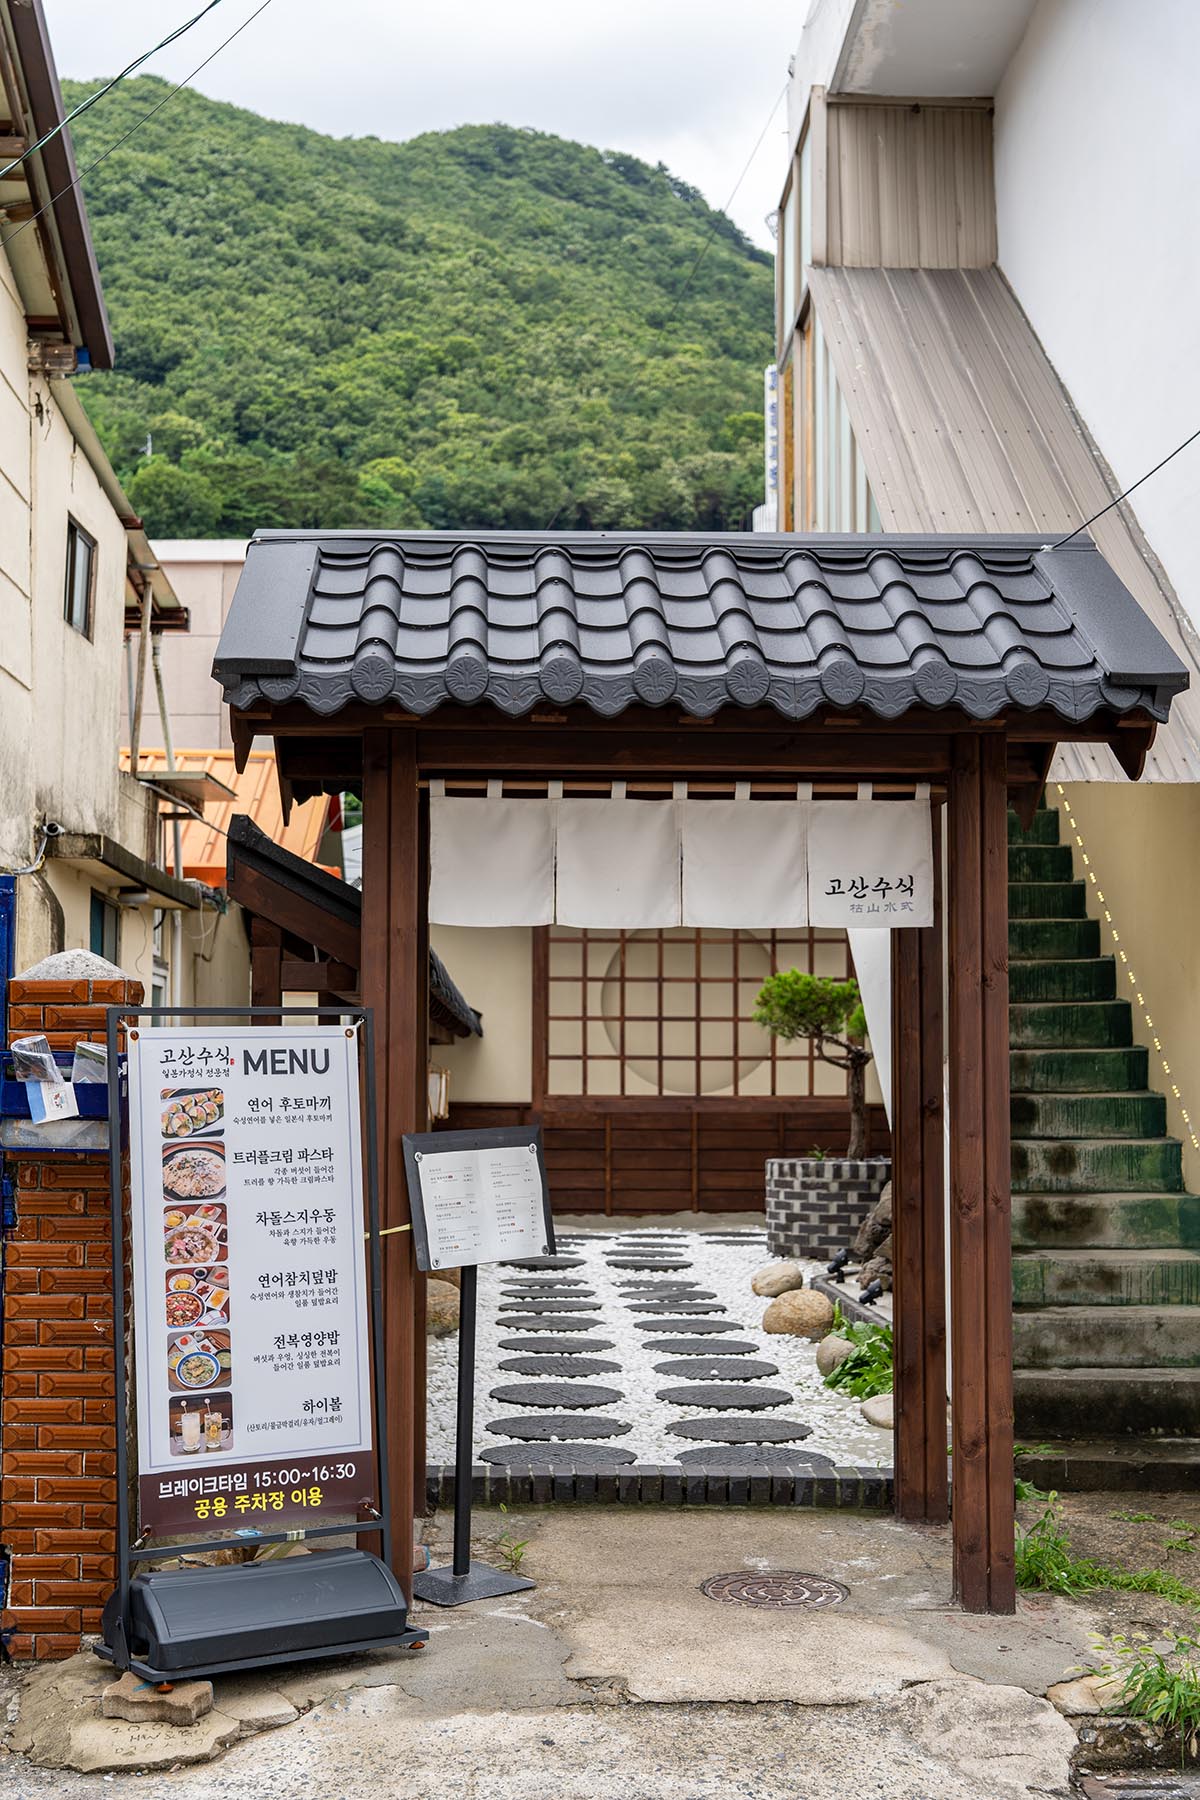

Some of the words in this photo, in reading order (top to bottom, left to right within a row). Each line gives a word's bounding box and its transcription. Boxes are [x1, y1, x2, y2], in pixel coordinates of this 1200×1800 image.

[825, 874, 914, 899] 고산수식
[160, 1046, 230, 1066] 고산수식
[243, 1048, 330, 1076] MENU
[162, 1068, 203, 1079] 일본가정식
[206, 1068, 230, 1078] 전문점
[248, 1097, 272, 1112] 연어
[279, 1096, 331, 1112] 후토마끼
[284, 1115, 304, 1123] 일본식
[306, 1114, 332, 1122] 후토마끼
[232, 1148, 293, 1165] 트러플크림
[297, 1147, 334, 1163] 파스타
[313, 1165, 334, 1174] 들어간
[256, 1208, 336, 1226] 차돌스지우동
[292, 1228, 313, 1236] 스지가
[316, 1226, 336, 1235] 들어간
[323, 1236, 336, 1244] 우동
[258, 1268, 338, 1288] 연어참치덮밥
[317, 1287, 338, 1296] 들어간
[274, 1330, 340, 1349] 전복영양밥
[253, 1354, 275, 1363] 버섯과
[296, 1350, 317, 1360] 싱싱한
[273, 1362, 294, 1372] 들어간
[302, 1396, 342, 1414] 하이볼
[158, 1473, 248, 1499] 브레이크타임
[254, 1463, 356, 1488] 15:00~16:30
[194, 1497, 228, 1519] 공용
[234, 1490, 284, 1514] 주차장
[290, 1486, 323, 1507] 이용
